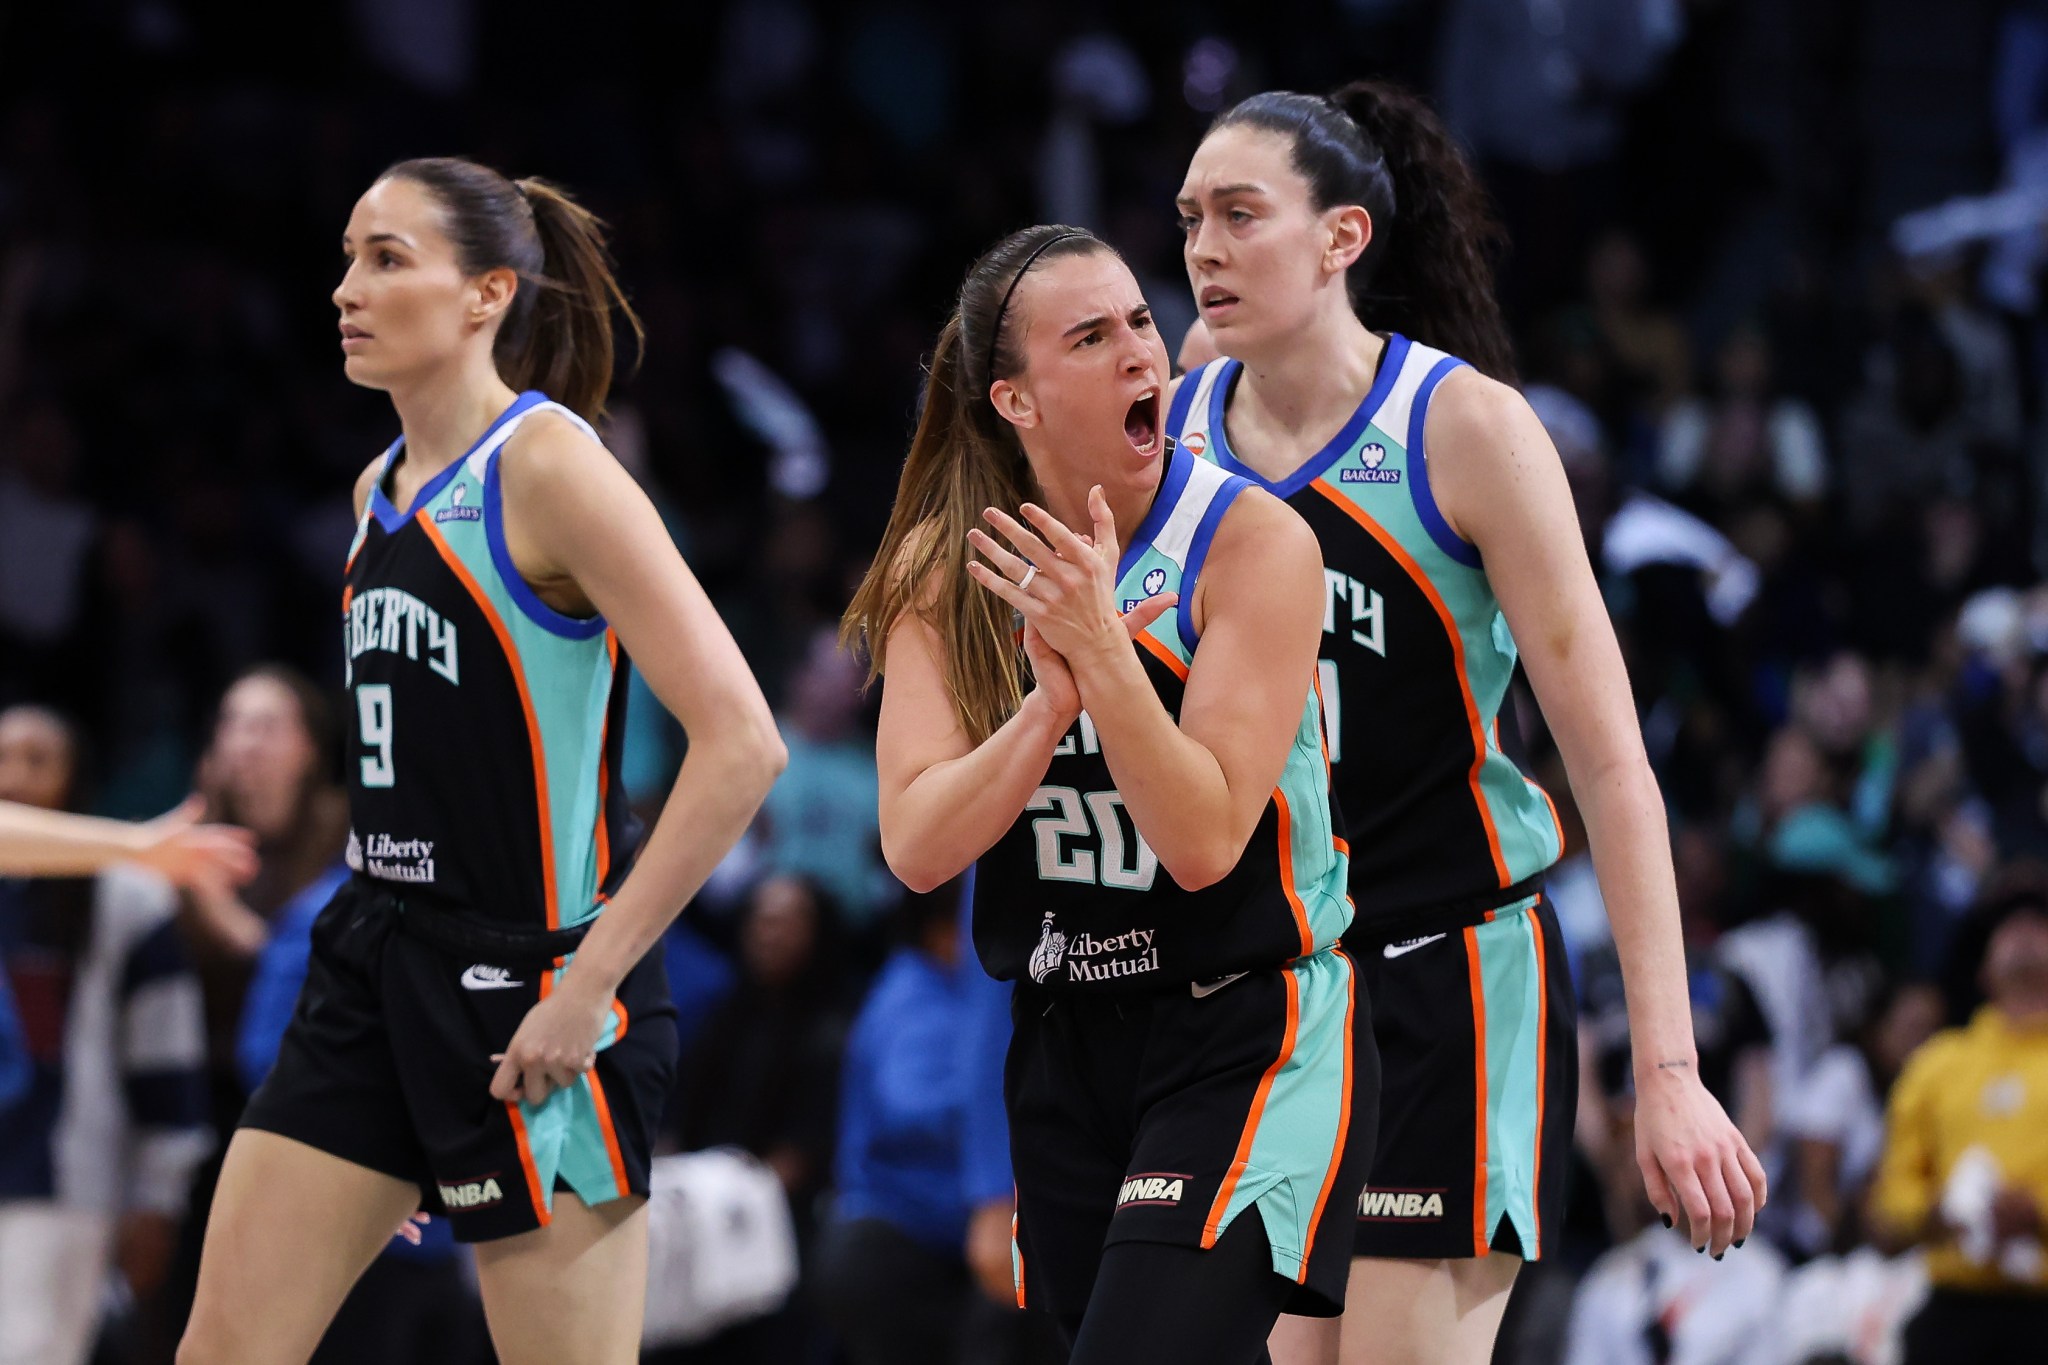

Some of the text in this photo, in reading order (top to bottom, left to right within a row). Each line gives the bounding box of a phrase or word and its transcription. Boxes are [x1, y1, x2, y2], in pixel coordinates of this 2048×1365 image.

[1342, 469, 1399, 482] BARCLAYS
[344, 587, 459, 689] BERTY
[356, 683, 395, 788] 9
[367, 833, 434, 866] Liberty
[1025, 785, 1158, 891] 20
[368, 859, 434, 882] Mutual
[1068, 928, 1155, 956] Liberty
[1068, 947, 1160, 981] Mutual
[1119, 1178, 1183, 1206] WNBA
[1362, 1192, 1443, 1217] WNBA
